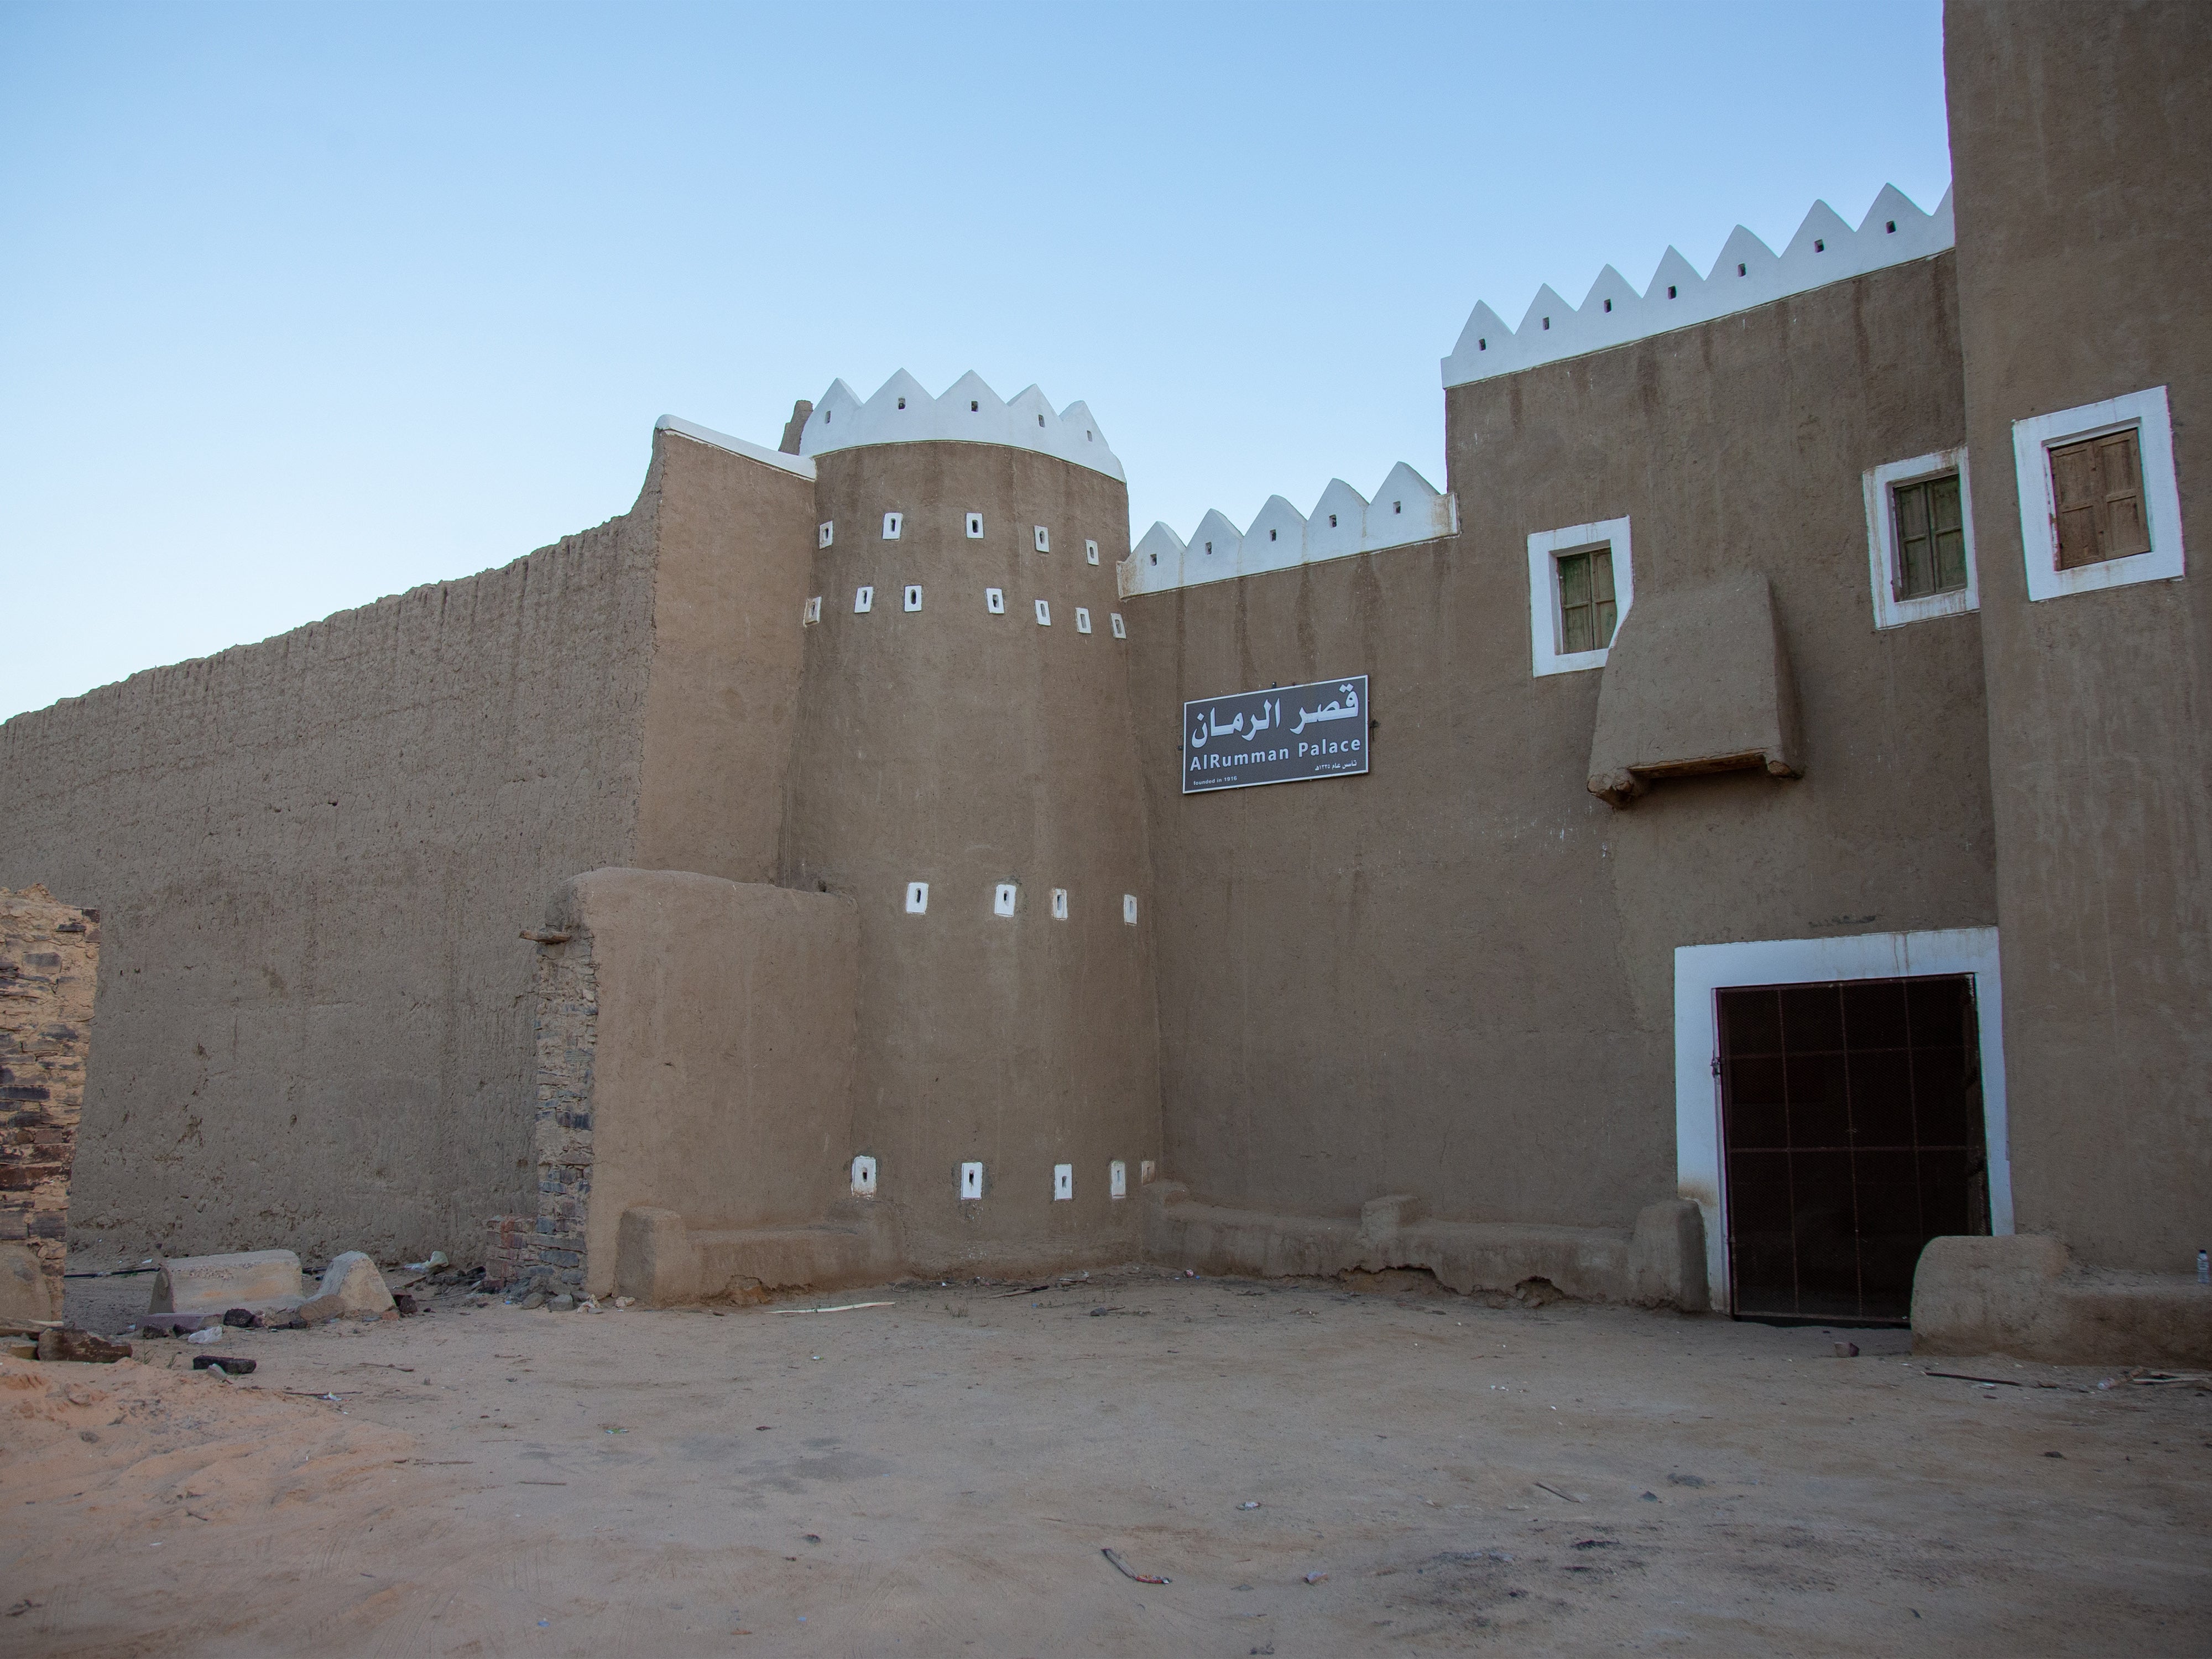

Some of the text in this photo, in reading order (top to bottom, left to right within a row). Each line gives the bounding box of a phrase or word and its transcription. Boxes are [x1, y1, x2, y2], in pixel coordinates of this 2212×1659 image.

[1191, 683, 1359, 748] قصر الرمان
[1190, 739, 1360, 771] AlRumman Palace
